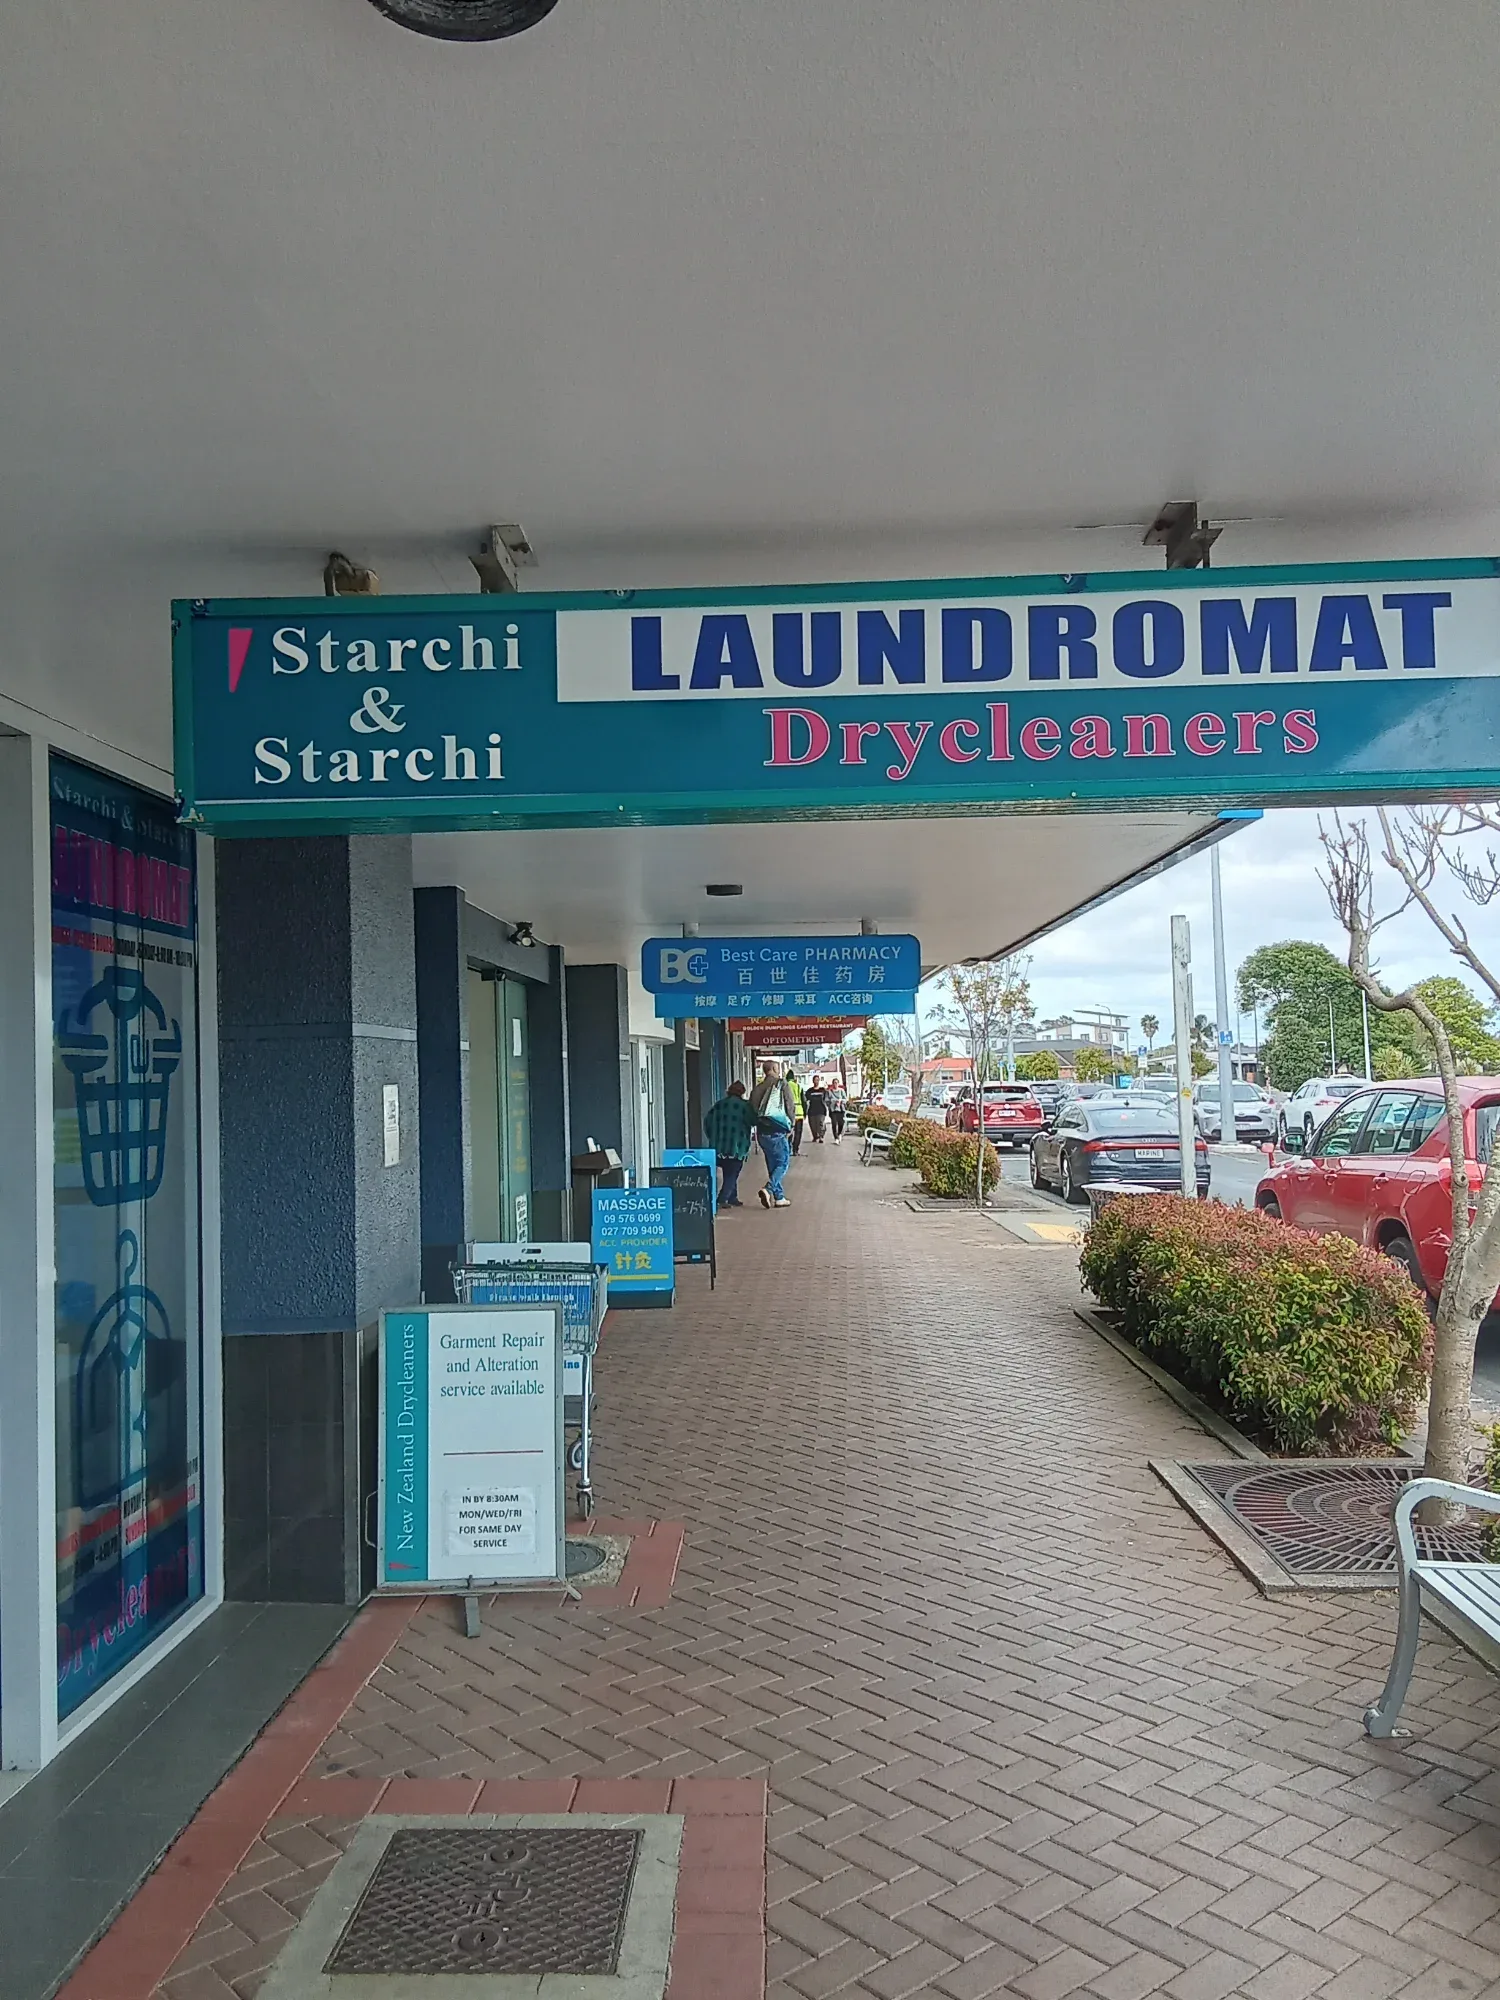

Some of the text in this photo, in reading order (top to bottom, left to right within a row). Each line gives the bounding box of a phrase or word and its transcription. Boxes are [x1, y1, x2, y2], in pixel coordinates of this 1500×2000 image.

[271, 624, 523, 675] Starchi
[632, 591, 1452, 692] LAUNDROMAT
[349, 686, 406, 735] &
[763, 702, 1319, 782] Drycleaners
[254, 733, 506, 785] Starchi
[720, 946, 902, 963] Best Care PHARMACY
[737, 964, 886, 985] 百世佳药房
[694, 995, 717, 1008] 按摩
[727, 994, 752, 1007] 足疗
[762, 1035, 826, 1044] OPTOMETRIST
[598, 1197, 667, 1211] MASSAGE
[603, 1213, 661, 1223] 09 576 0699
[601, 1225, 665, 1236] 027 709 9409
[620, 1238, 668, 1246] PROVIDER
[440, 1331, 545, 1351] Garment Repair
[446, 1356, 539, 1373] and Alteration
[440, 1380, 545, 1397] service available
[397, 1323, 416, 1551] New Zealand Drycleaners
[462, 1494, 519, 1503] IN BY 8:30AM
[459, 1508, 522, 1520] MON/WED/FRI
[459, 1524, 522, 1534] FOR SAME DAY
[473, 1539, 508, 1548] SERVICE
